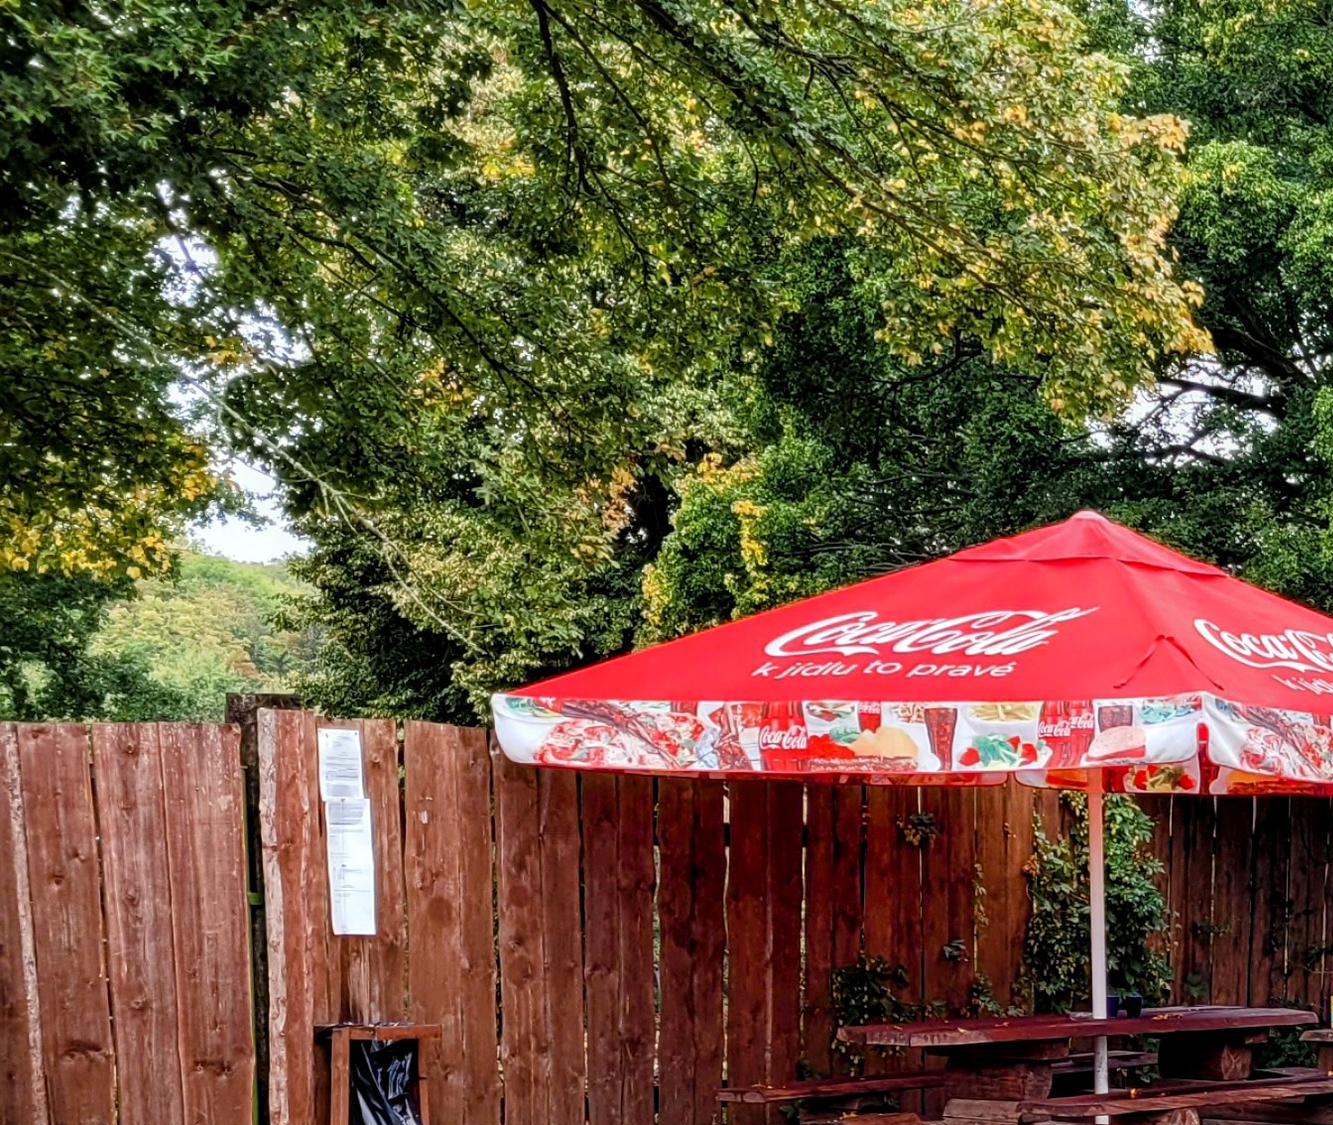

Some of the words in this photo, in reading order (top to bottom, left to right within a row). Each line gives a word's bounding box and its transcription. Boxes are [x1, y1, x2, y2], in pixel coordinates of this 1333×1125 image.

[764, 606, 1101, 657] Coca-Cola
[751, 661, 780, 677] k
[774, 660, 859, 680] jídlu
[863, 659, 904, 676] to
[906, 660, 1018, 679] pravé
